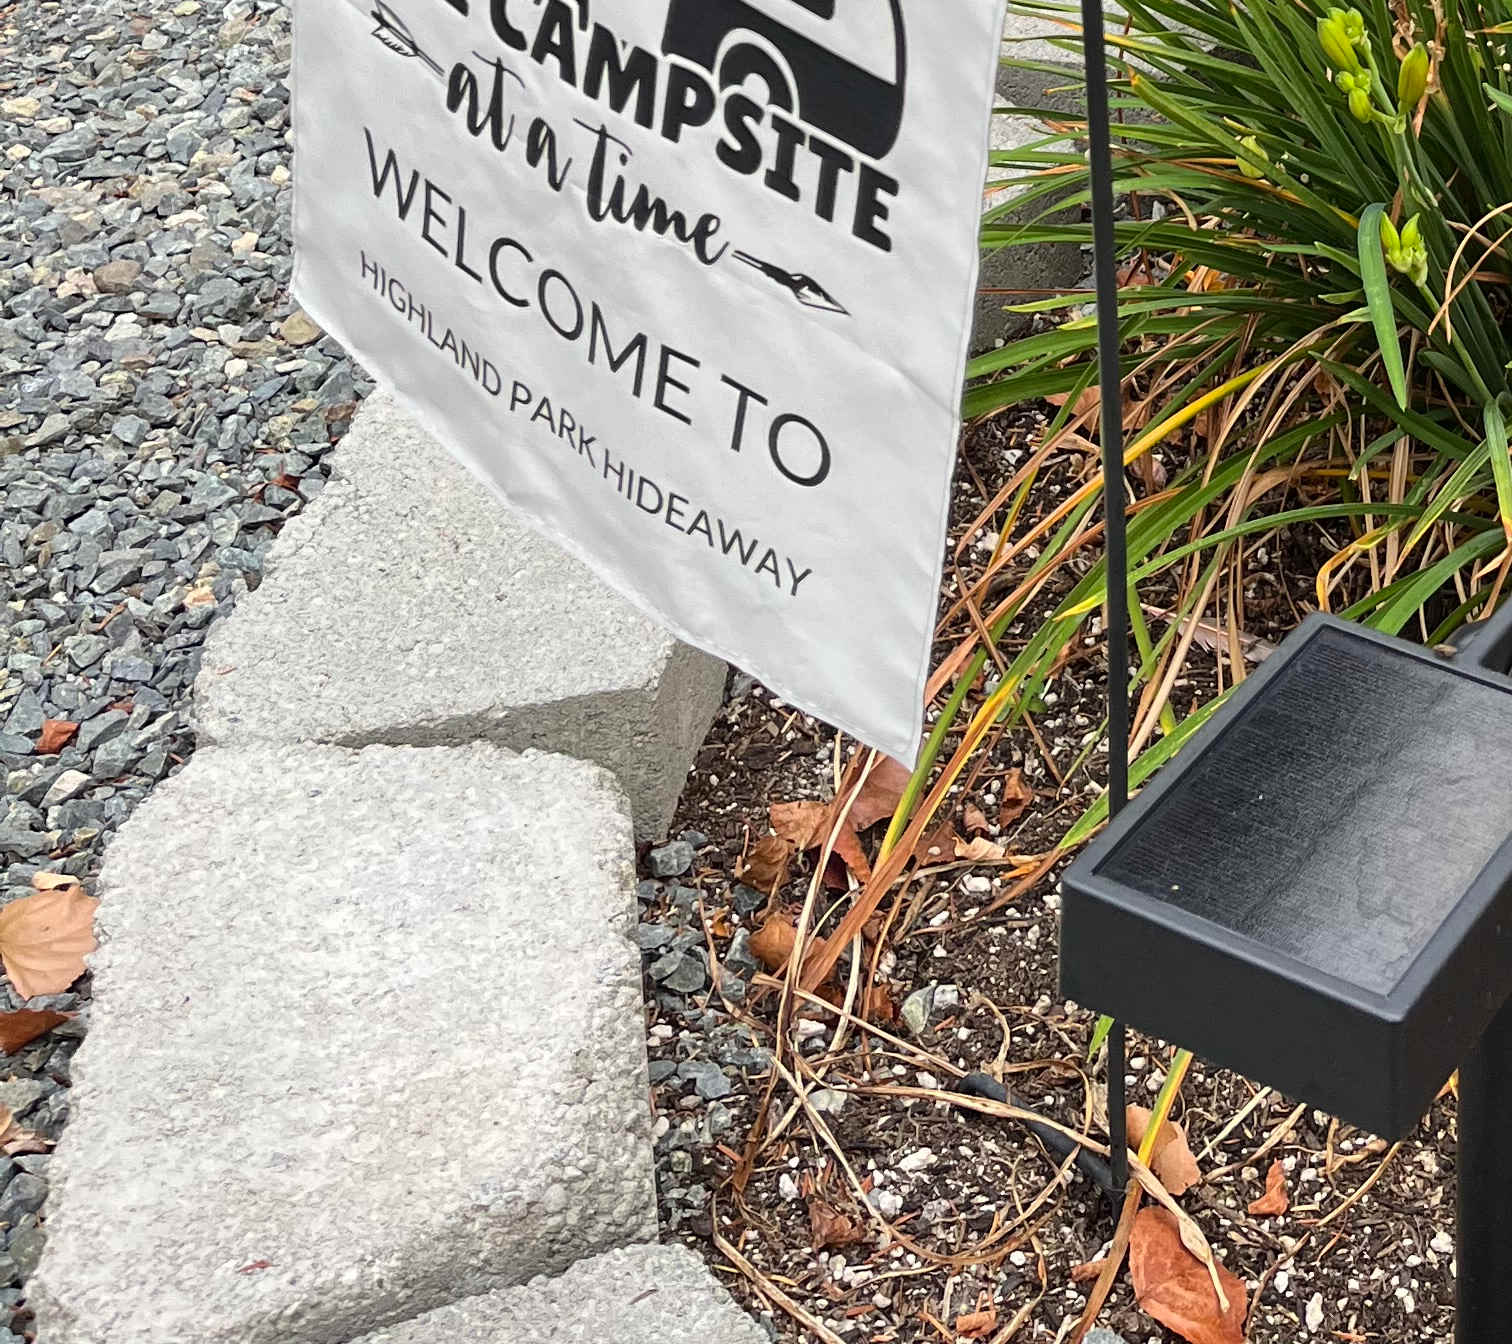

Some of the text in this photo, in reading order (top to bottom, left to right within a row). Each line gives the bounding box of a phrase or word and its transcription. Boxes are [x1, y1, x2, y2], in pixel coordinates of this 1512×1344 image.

[363, 126, 832, 488] WELCOME TO
[446, 50, 730, 266] at a time
[360, 249, 813, 598] HIGHLAND PARK HIDEAWAY
